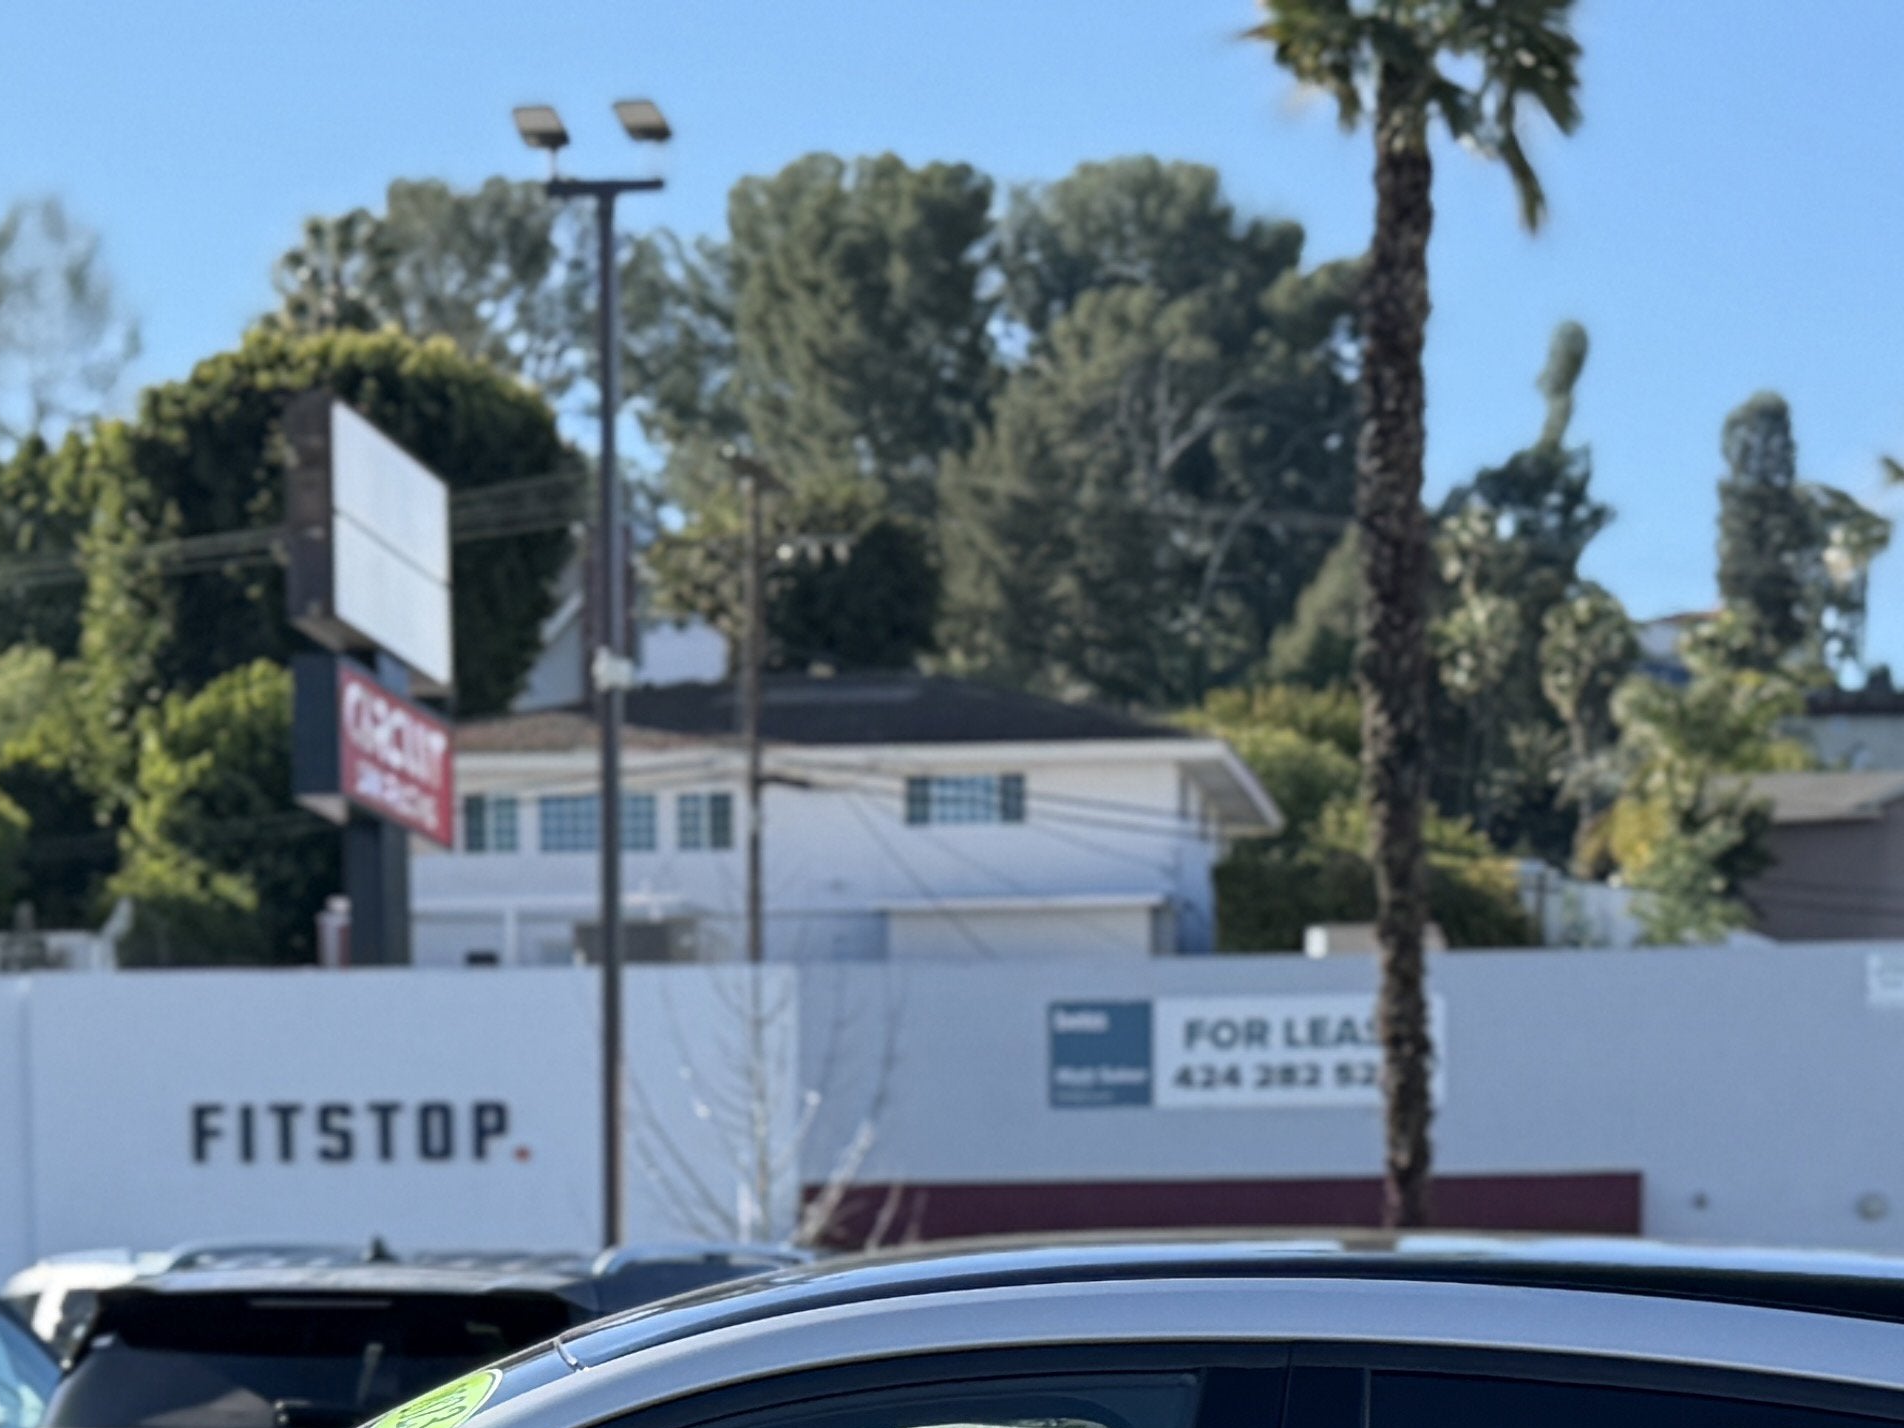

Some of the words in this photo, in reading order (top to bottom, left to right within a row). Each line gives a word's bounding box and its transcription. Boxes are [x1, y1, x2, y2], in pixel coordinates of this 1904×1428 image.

[1183, 1018, 1272, 1050] FOR
[1283, 1016, 1383, 1048] LEAS
[1173, 1063, 1243, 1091] 424
